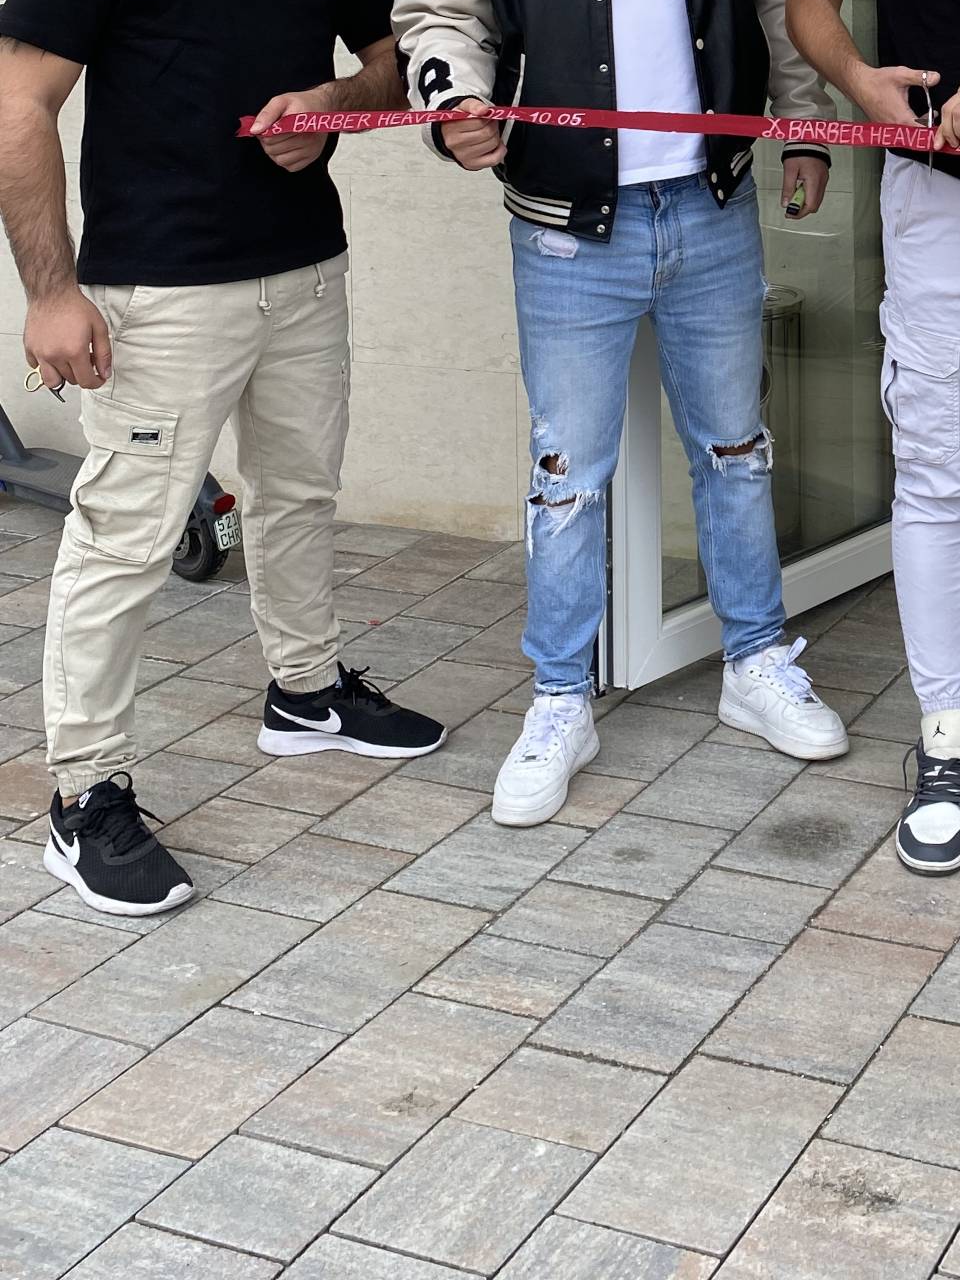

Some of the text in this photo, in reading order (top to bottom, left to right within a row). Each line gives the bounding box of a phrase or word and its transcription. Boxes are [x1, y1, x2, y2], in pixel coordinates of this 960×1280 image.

[293, 114, 371, 132] BARBER
[378, 112, 454, 127] HEAVEN
[788, 120, 864, 144] BARBER
